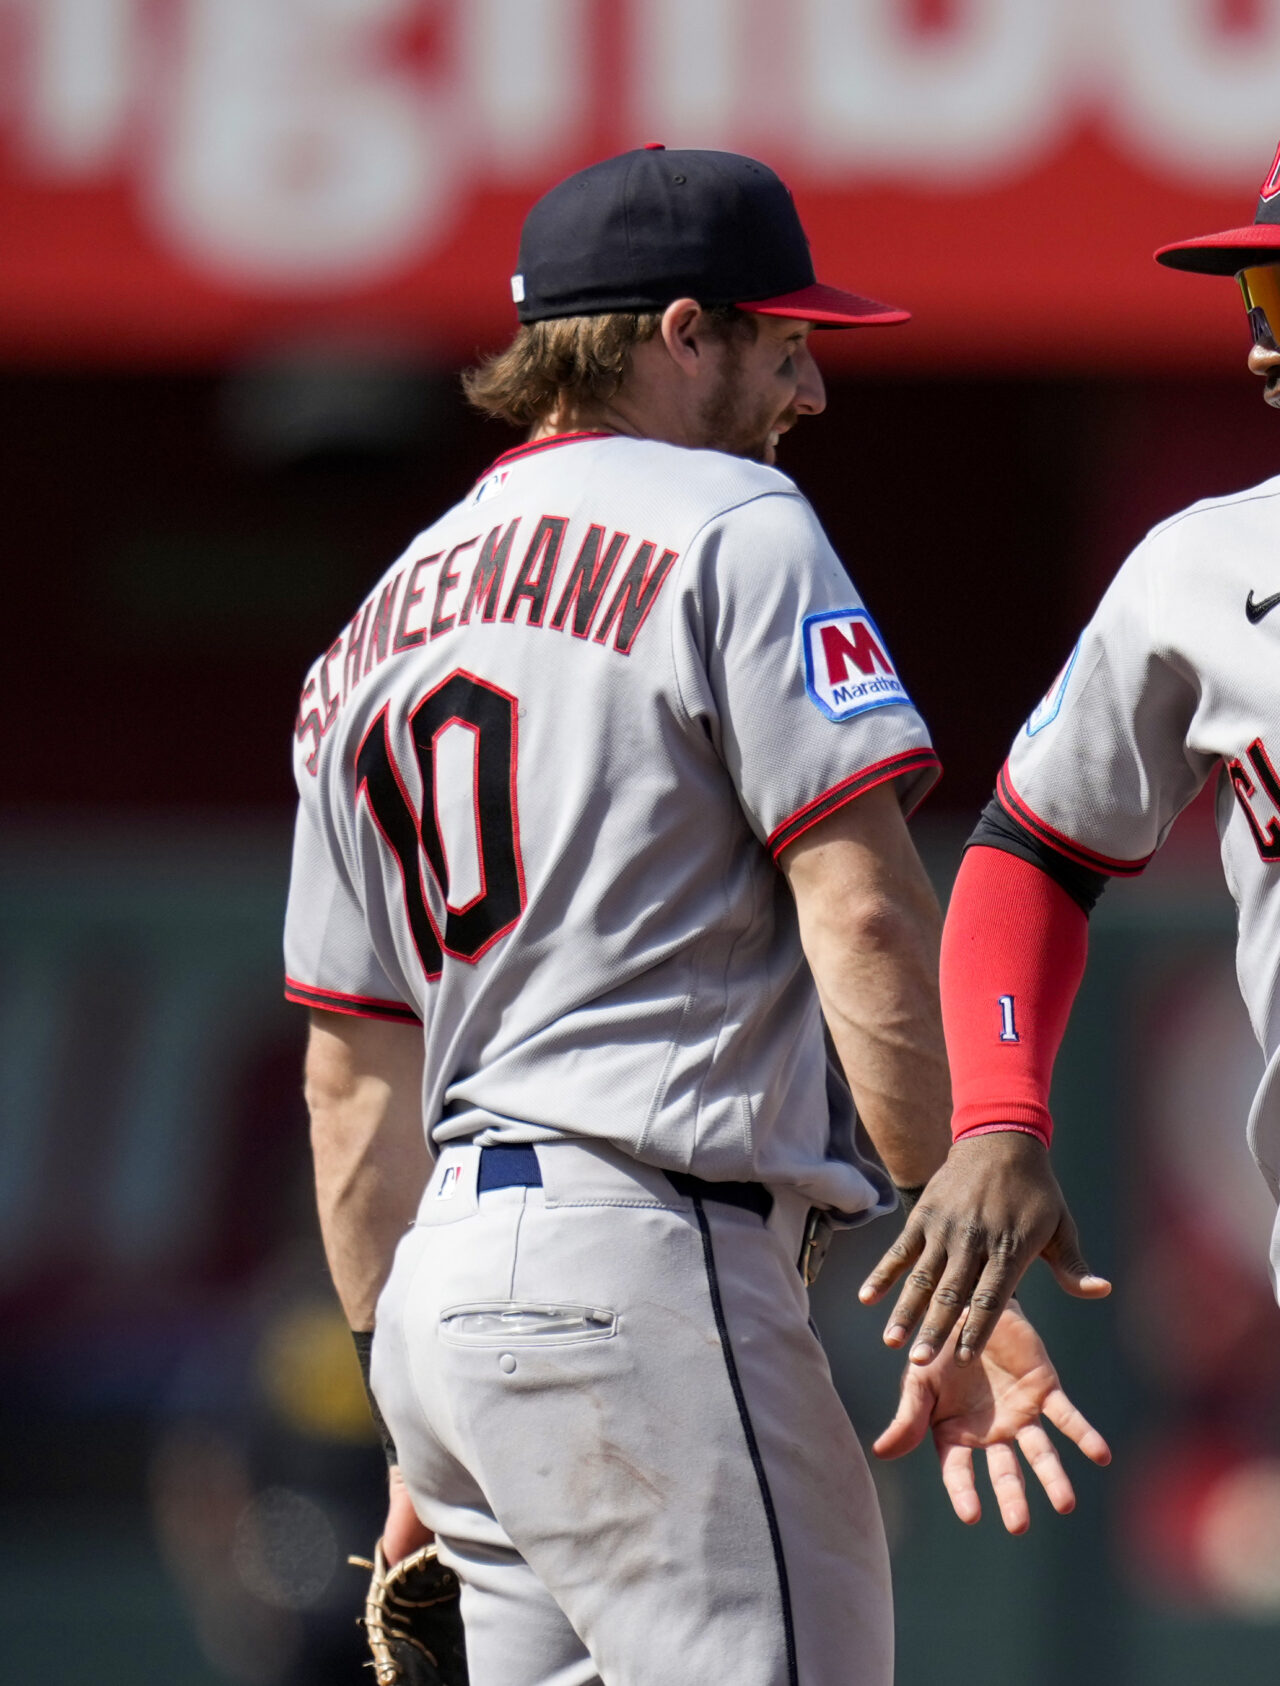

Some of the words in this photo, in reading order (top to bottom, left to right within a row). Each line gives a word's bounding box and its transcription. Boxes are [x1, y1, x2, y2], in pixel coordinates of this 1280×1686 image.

[295, 515, 680, 777] SCHNEEMANN
[820, 621, 895, 687] M
[832, 677, 902, 706] Maratho
[354, 667, 528, 983] 10
[998, 994, 1020, 1042] 1
